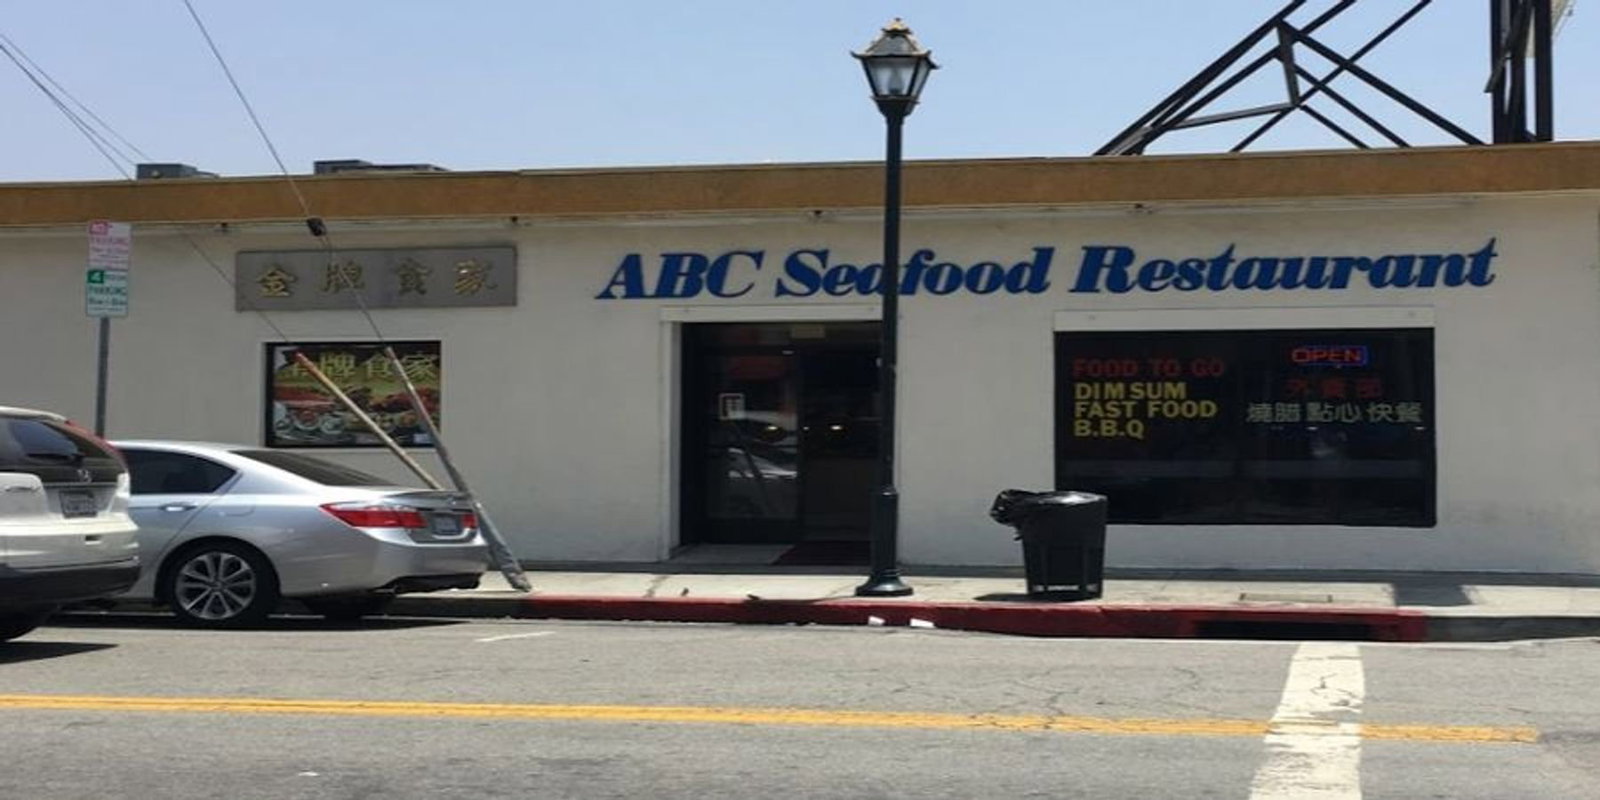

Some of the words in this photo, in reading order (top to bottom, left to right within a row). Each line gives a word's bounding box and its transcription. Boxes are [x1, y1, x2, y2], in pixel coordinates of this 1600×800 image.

[595, 249, 765, 300] ABC
[775, 246, 1056, 299] Seafood
[1069, 237, 1499, 293] Restaurant
[1291, 348, 1362, 364] OPEN
[1072, 358, 1138, 378] FOOD
[1151, 358, 1181, 377] TO
[1191, 358, 1225, 377] GO
[1074, 382, 1125, 400] DIM
[1129, 382, 1187, 400] SUM
[1074, 400, 1138, 418] FAST
[1147, 400, 1218, 418] FOOD
[1073, 419, 1146, 439] B.B.Q
